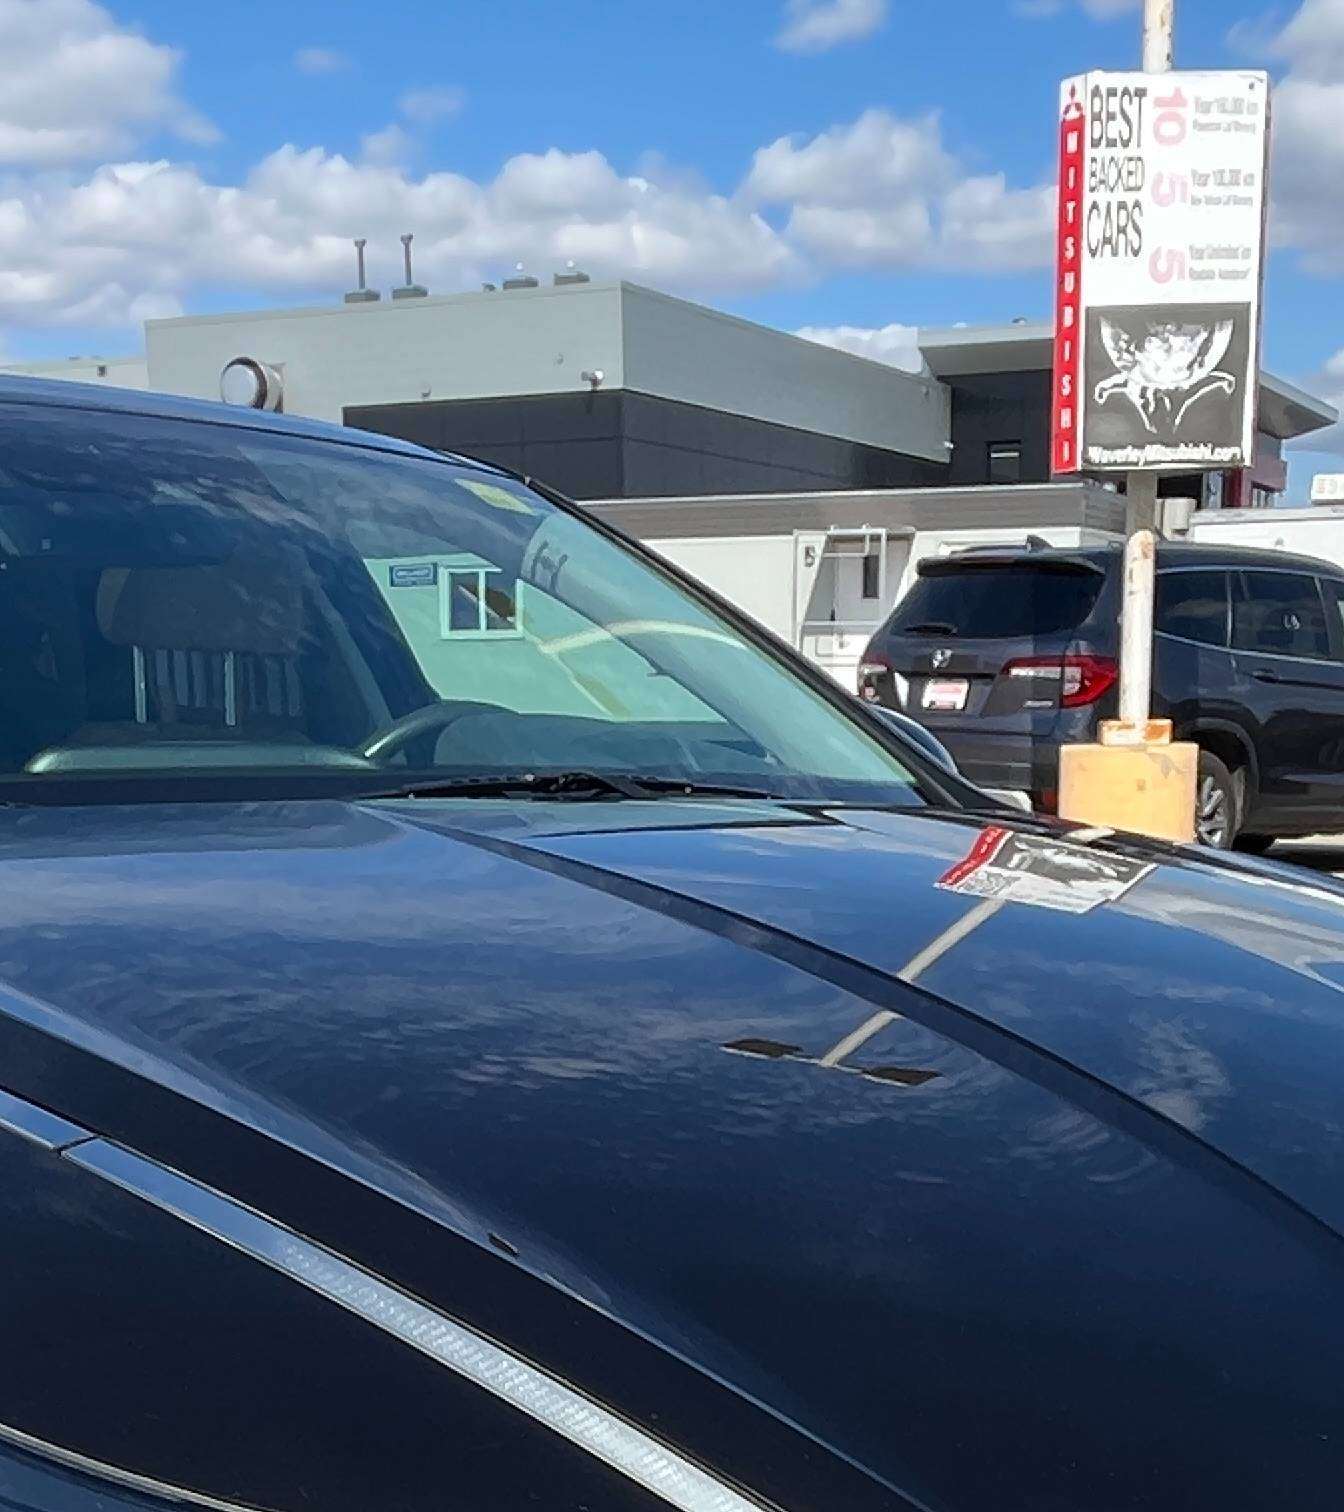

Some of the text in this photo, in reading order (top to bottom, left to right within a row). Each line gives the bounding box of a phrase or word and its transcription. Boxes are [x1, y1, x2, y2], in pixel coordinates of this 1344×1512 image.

[1090, 85, 1147, 150] BEST
[1153, 86, 1188, 147] 10
[1088, 155, 1145, 193] BACKED
[1151, 171, 1189, 208] 5
[1087, 199, 1144, 258] CARS
[1148, 245, 1187, 285] 5
[1060, 131, 1080, 462] MITSUBISHI
